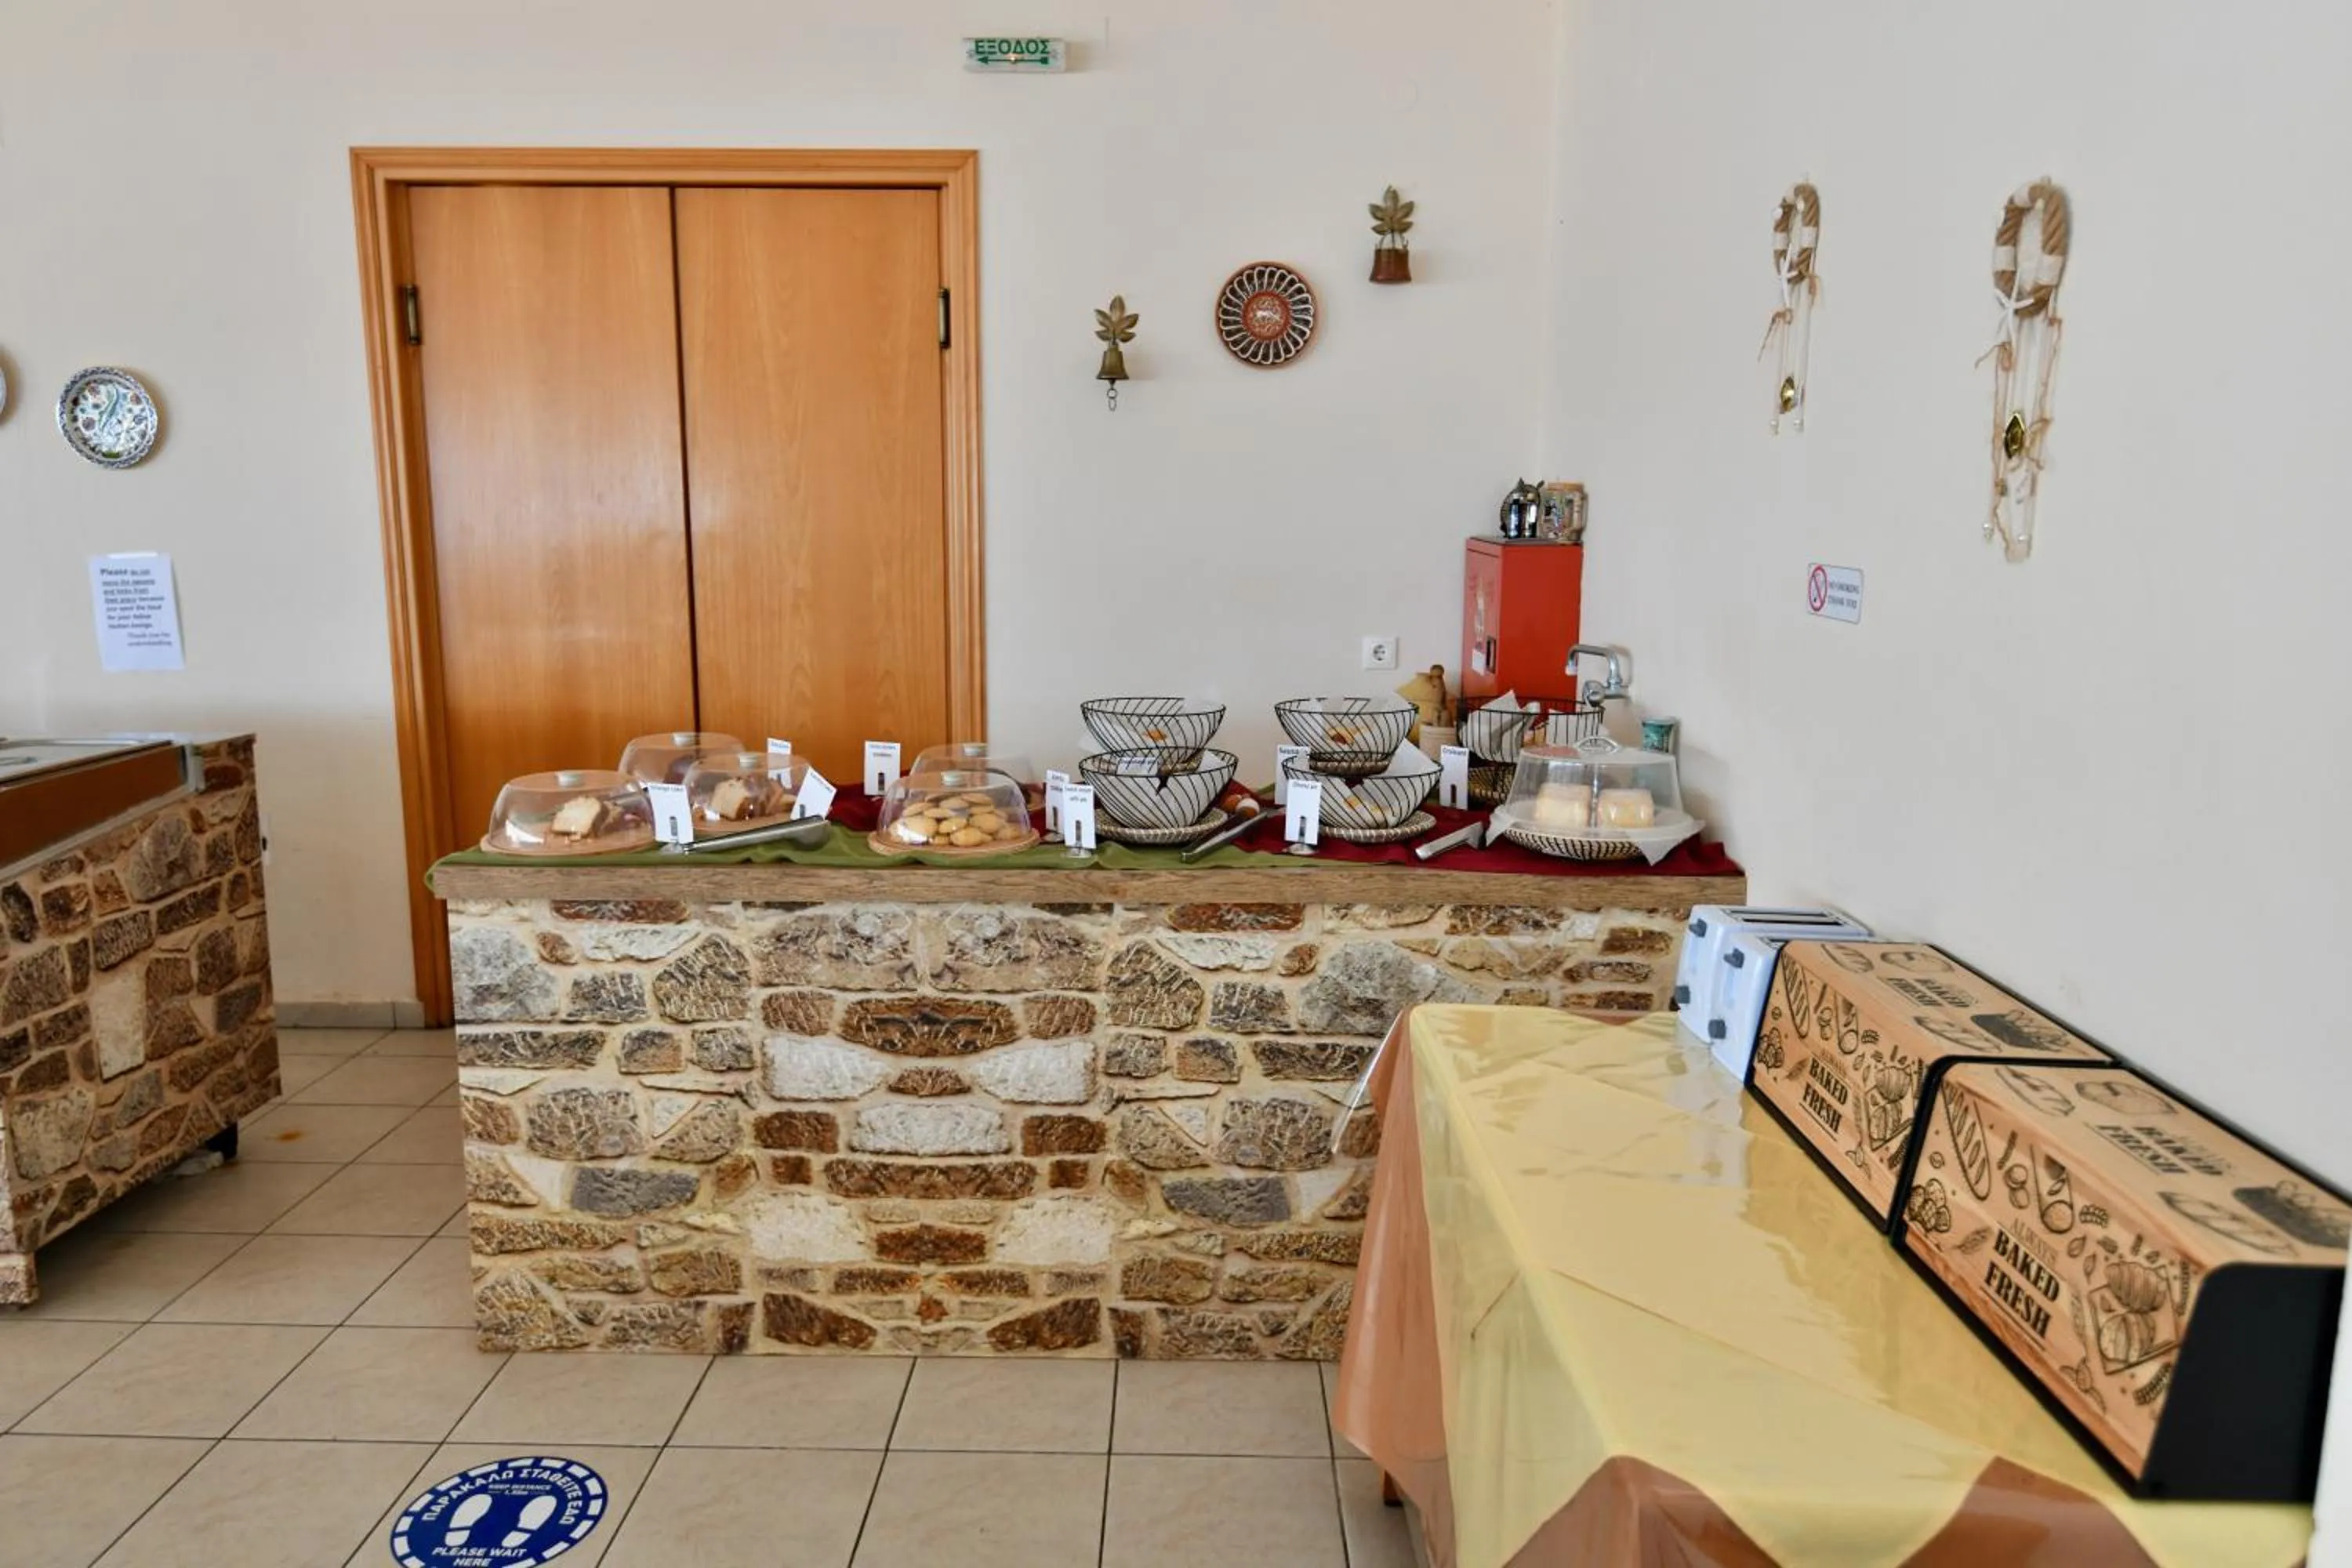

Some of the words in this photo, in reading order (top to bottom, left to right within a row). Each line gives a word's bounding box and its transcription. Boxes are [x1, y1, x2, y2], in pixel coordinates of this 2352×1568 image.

[975, 39, 1050, 54] ΕΞΟΔΟΣ
[1809, 1057, 1848, 1105] BAKED
[1803, 1082, 1842, 1134] FRESH
[1994, 1229, 2060, 1302] BAKED
[1984, 1260, 2053, 1338] FRESH
[422, 1470, 514, 1521] ΠΑΡΑΚΑΛΩ
[432, 1547, 487, 1556] PLEASE
[490, 1548, 528, 1557] WAIT
[453, 1558, 494, 1567] HERE
